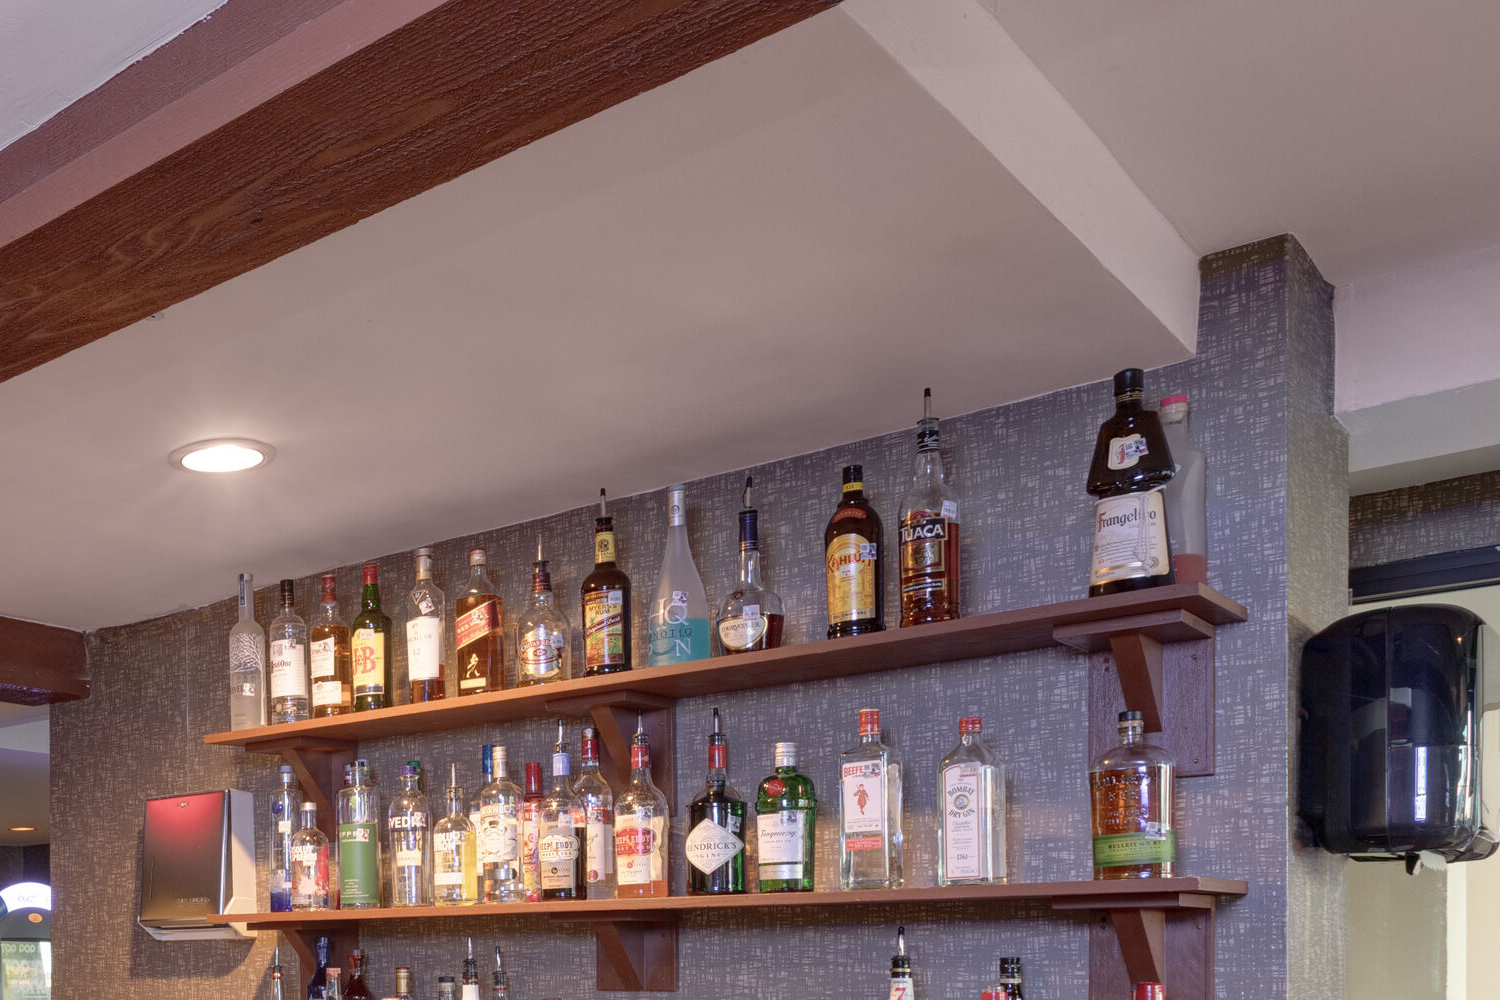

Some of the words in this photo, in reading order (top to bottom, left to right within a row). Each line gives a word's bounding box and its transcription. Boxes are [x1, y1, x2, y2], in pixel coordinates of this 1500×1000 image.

[901, 524, 944, 543] TUACA
[843, 765, 864, 777] BEEFE
[947, 785, 975, 797] BOMBAY
[948, 808, 961, 819] DRY
[962, 807, 976, 818] GIN
